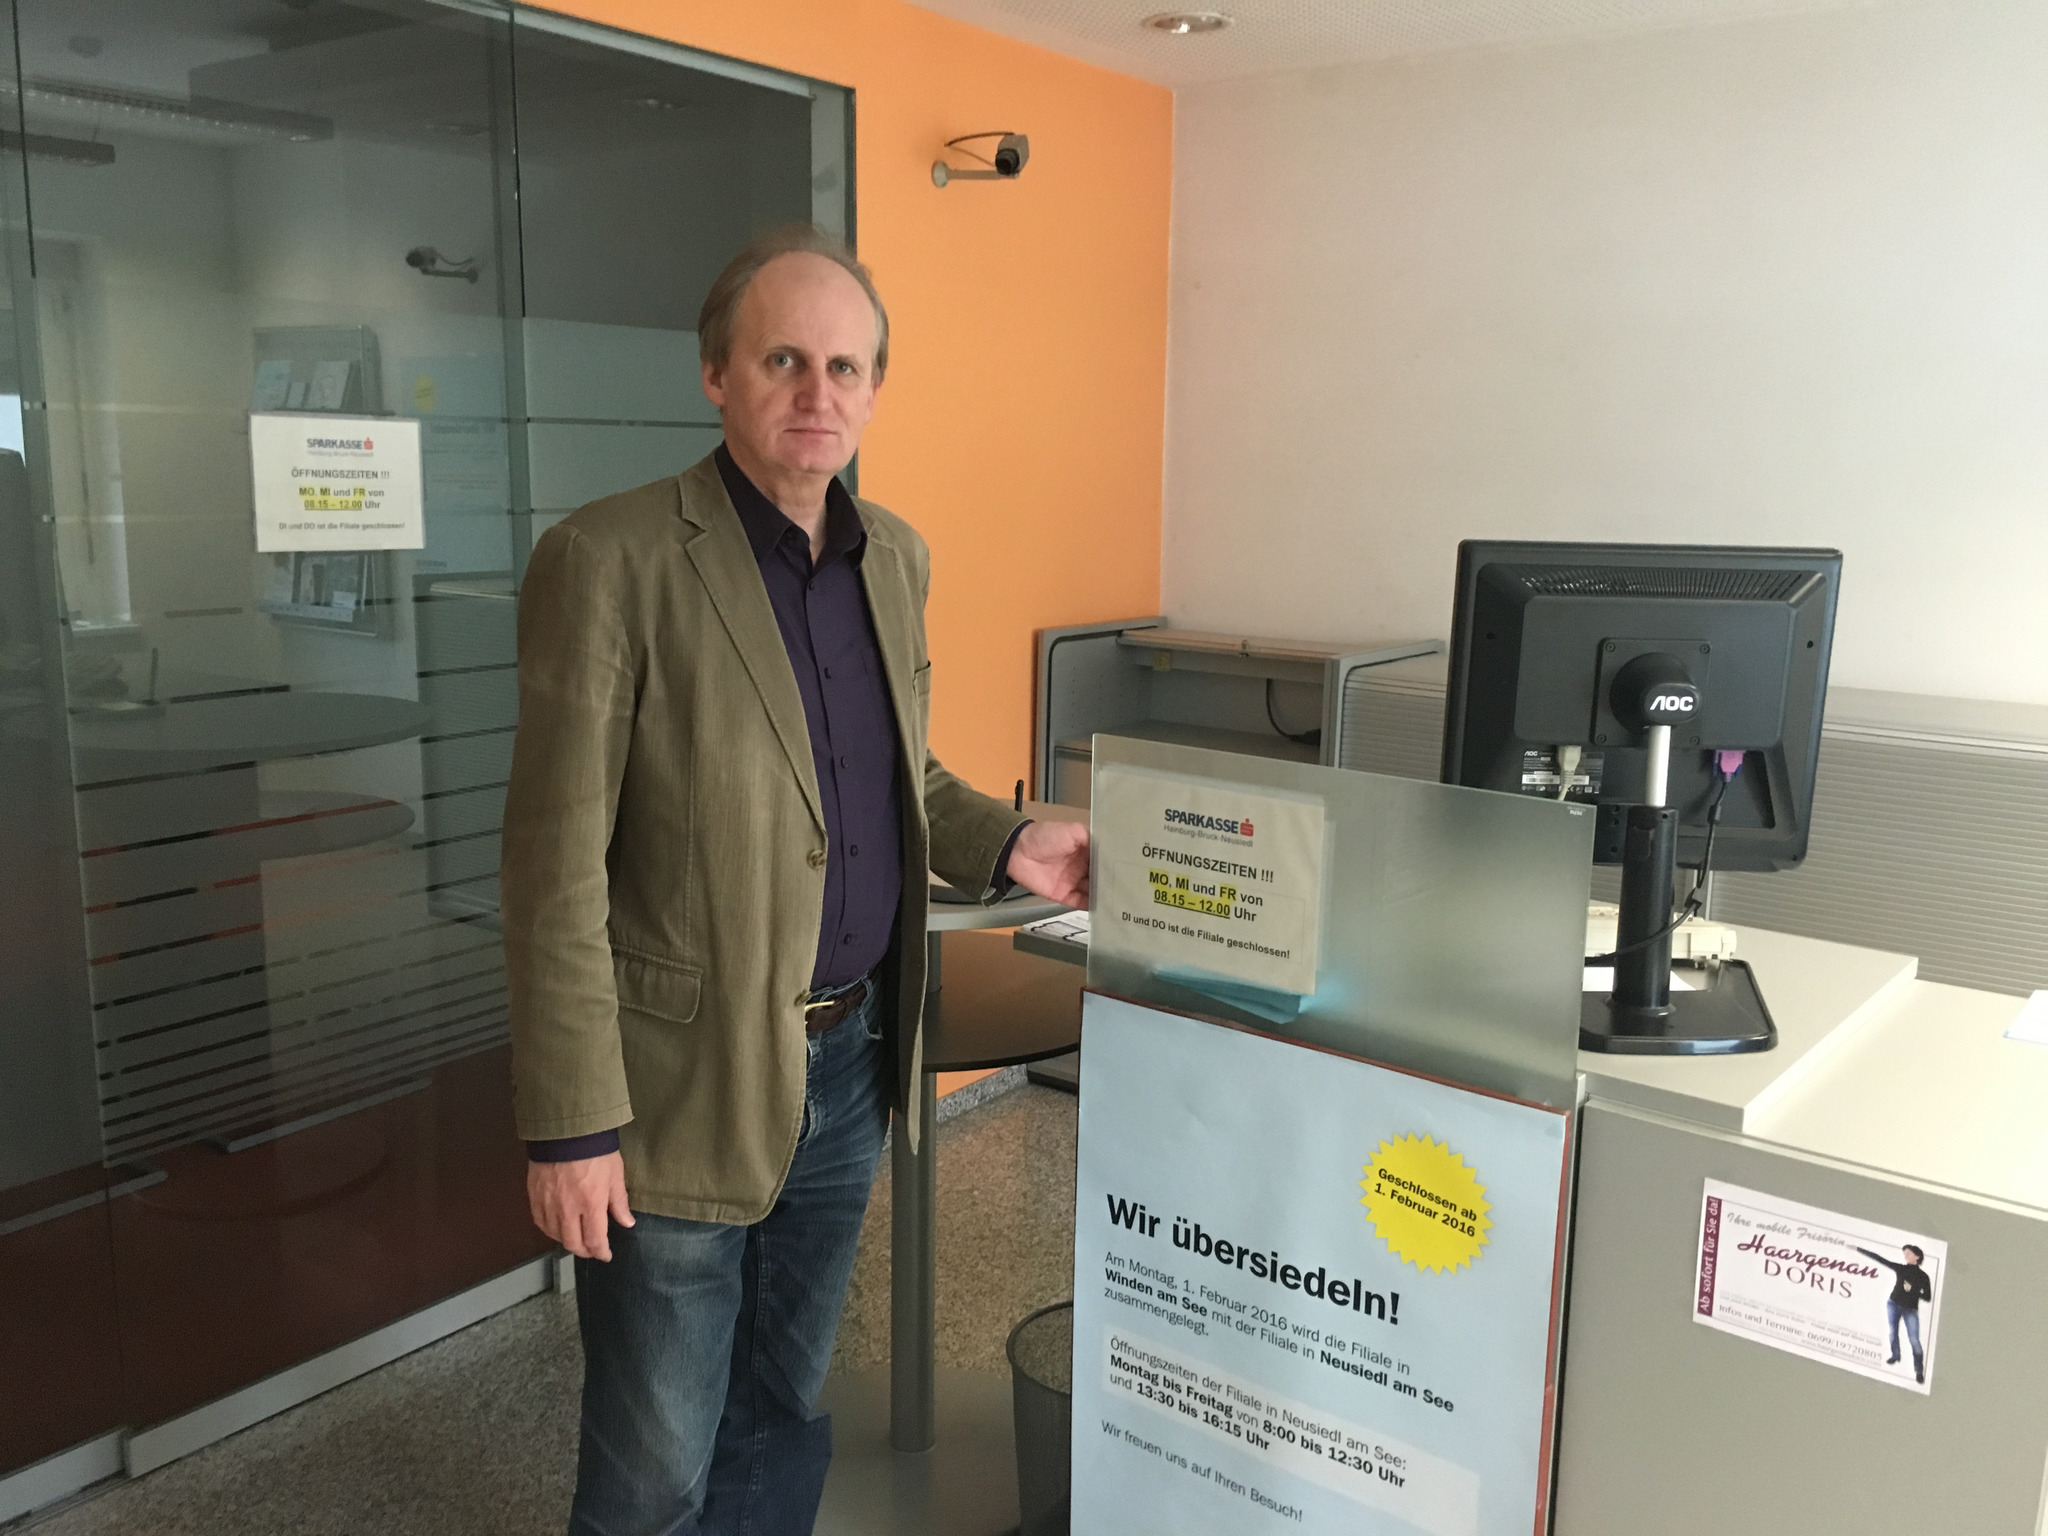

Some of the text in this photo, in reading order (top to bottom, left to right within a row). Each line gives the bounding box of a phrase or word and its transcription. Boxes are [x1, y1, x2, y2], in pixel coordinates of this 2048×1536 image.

[306, 438, 362, 450] SPARKASSE
[291, 467, 378, 479] ÖFFNUNGSZEITEN
[320, 487, 331, 496] MI
[333, 488, 351, 497] und
[353, 487, 366, 497] FR
[368, 489, 385, 497] von
[304, 500, 328, 509] 08.15
[339, 500, 362, 509] 12.00
[364, 500, 381, 509] Uhr
[1649, 695, 1694, 712] AOC
[1164, 808, 1239, 834] SPARKASSE
[1142, 842, 1274, 883] ÖFFNUNGSZEITEN !!!
[1149, 871, 1263, 907] MO, MI und FR von
[1154, 889, 1185, 906] 08.15
[1199, 899, 1231, 916] 12.00
[1234, 907, 1257, 922] Uhr
[1122, 911, 1290, 960] DI und DO ist die Filiale geschlossen!
[1374, 1182, 1475, 1237] 1. Februar 2016
[1378, 1168, 1477, 1222] Geschlossen ab
[1727, 1212, 1751, 1228] Ihre
[1756, 1220, 1792, 1236] mobile
[1107, 1193, 1400, 1326] Wir übersiedeln!
[1700, 1198, 1719, 1313] Ab sofort für Sie da!
[1737, 1233, 1879, 1279] Haargenau
[1764, 1258, 1852, 1299] DORIS
[1104, 1287, 1209, 1337] zusammengelegt.
[1105, 1251, 1411, 1376] Am Montag, 1. Februar 2016 wird die Filiale in
[1718, 1304, 1742, 1318] Infos
[1744, 1313, 1762, 1325] und
[1105, 1267, 1454, 1413] Winden am See mit der Filiale in Neusiedl am See
[1110, 1335, 1407, 1470] Öffnungszeiten der Filiale in Neusiedl am See:
[1110, 1373, 1270, 1451] und 13:30 bis 16:15 Uhr
[1110, 1354, 1405, 1488] Montag bis Freitag von 8:00 bis 12:30 Uhr
[1101, 1419, 1303, 1522] Wir freuen uns auf Ihren Besuch!
